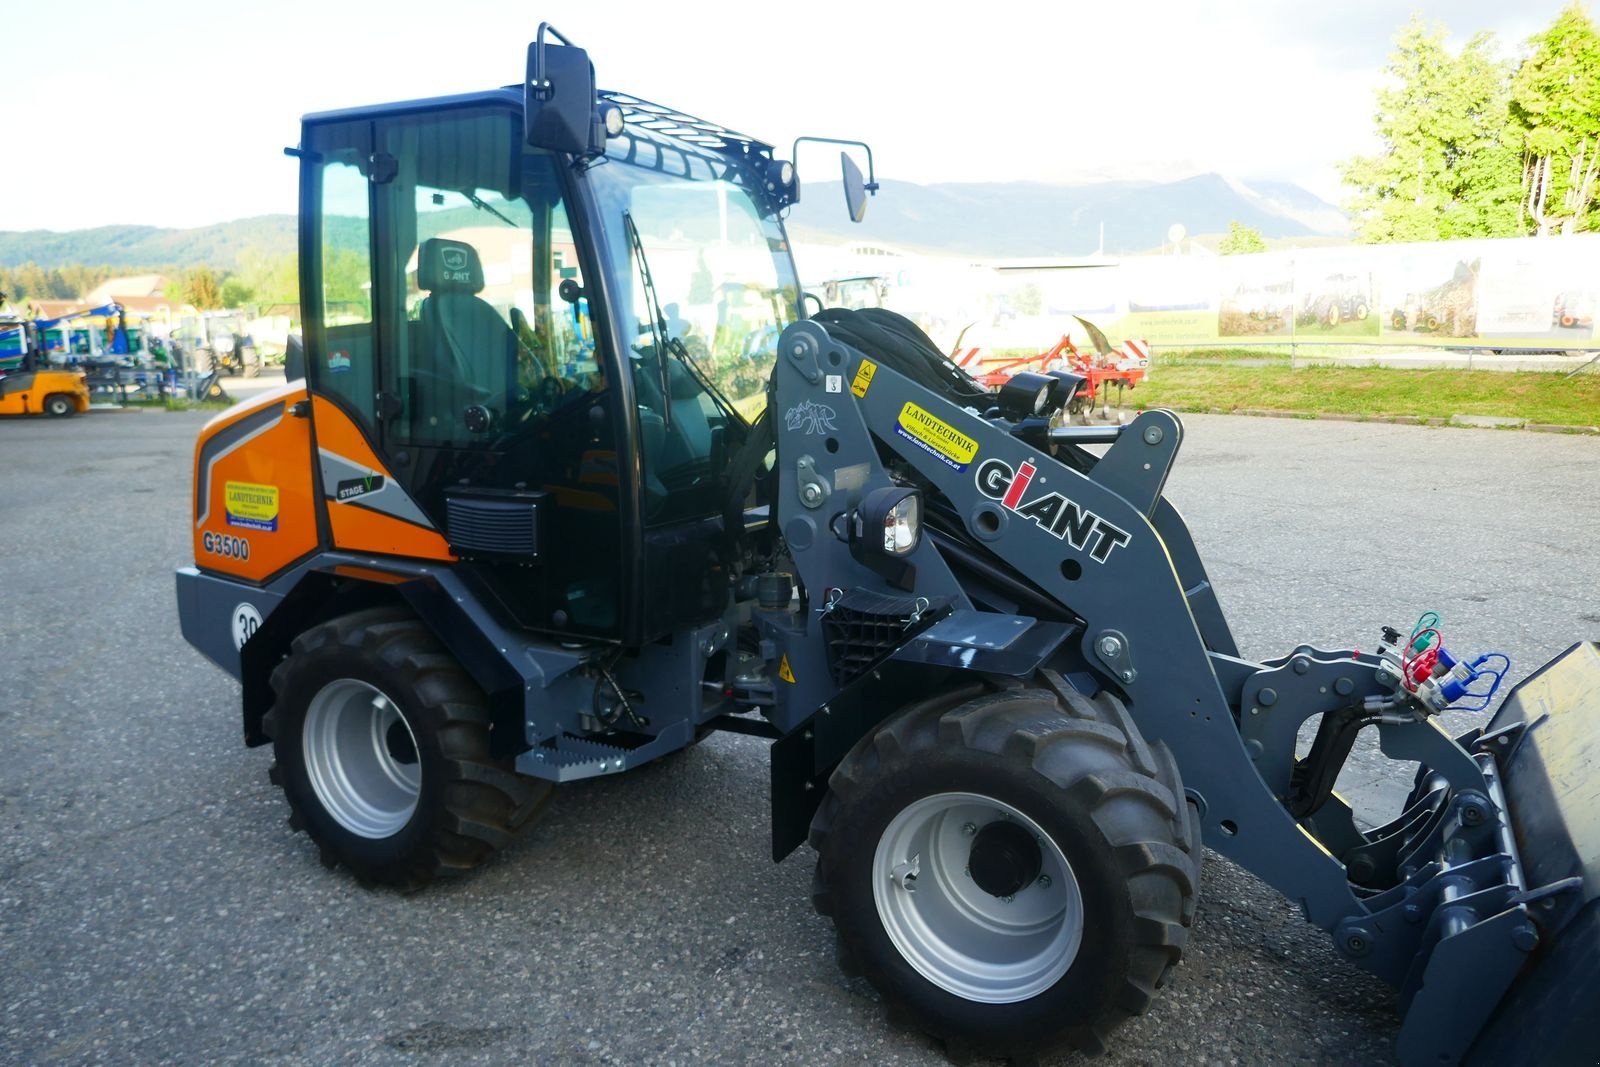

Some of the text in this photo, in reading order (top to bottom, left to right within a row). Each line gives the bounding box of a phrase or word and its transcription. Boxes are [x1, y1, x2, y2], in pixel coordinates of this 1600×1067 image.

[905, 406, 975, 453] LANDTECHNIK
[898, 429, 961, 471] www.landtechnik.co.at
[340, 484, 364, 498] STAGE
[203, 531, 250, 561] G3500
